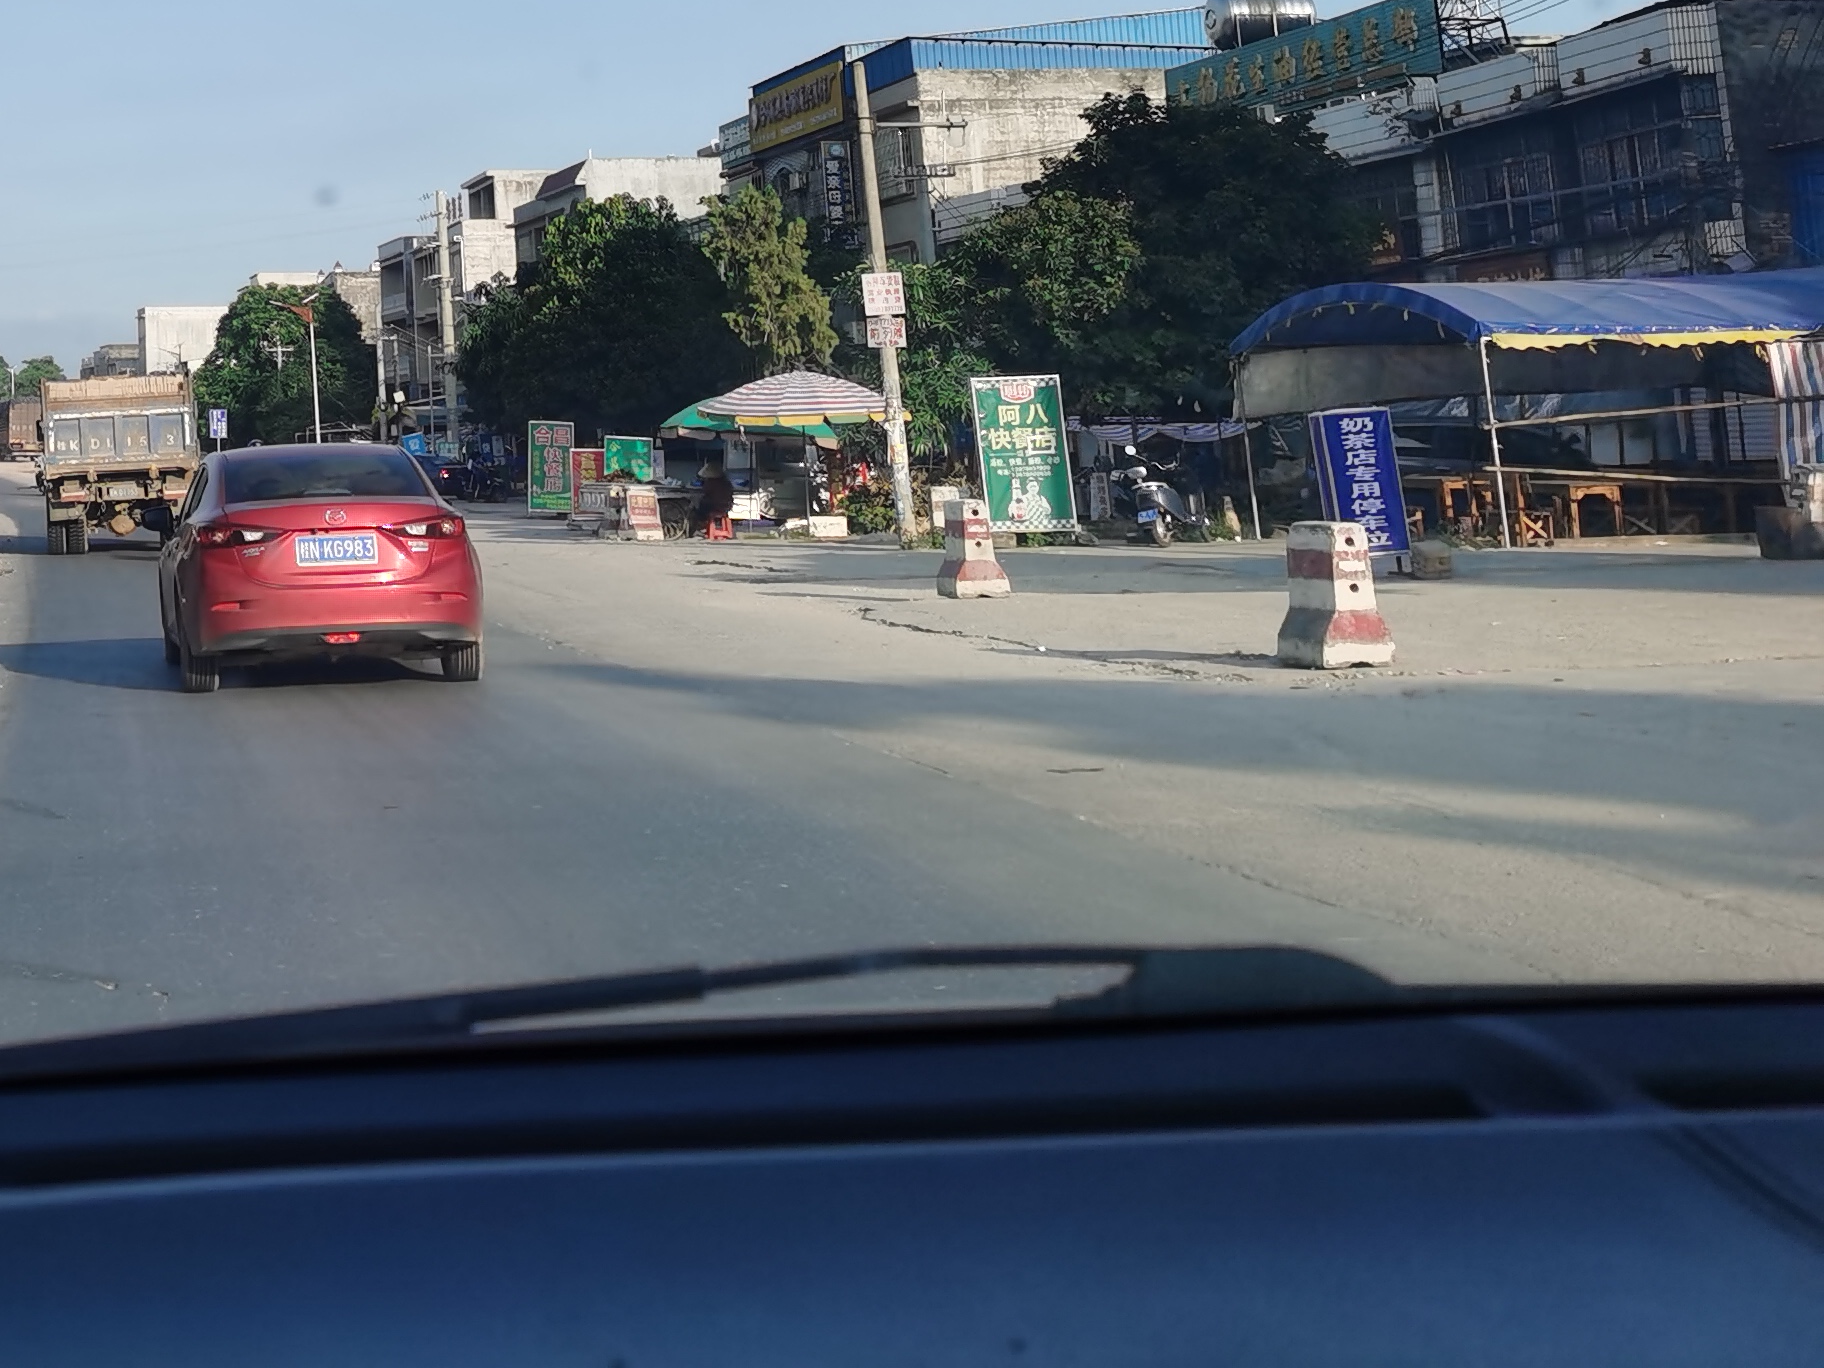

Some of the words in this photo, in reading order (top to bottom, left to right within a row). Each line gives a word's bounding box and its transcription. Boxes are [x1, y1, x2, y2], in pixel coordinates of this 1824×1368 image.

[998, 403, 1049, 426] 阿八
[534, 425, 571, 446] 合昌
[988, 426, 1057, 450] 快餐店
[543, 447, 564, 492] 快餐店
